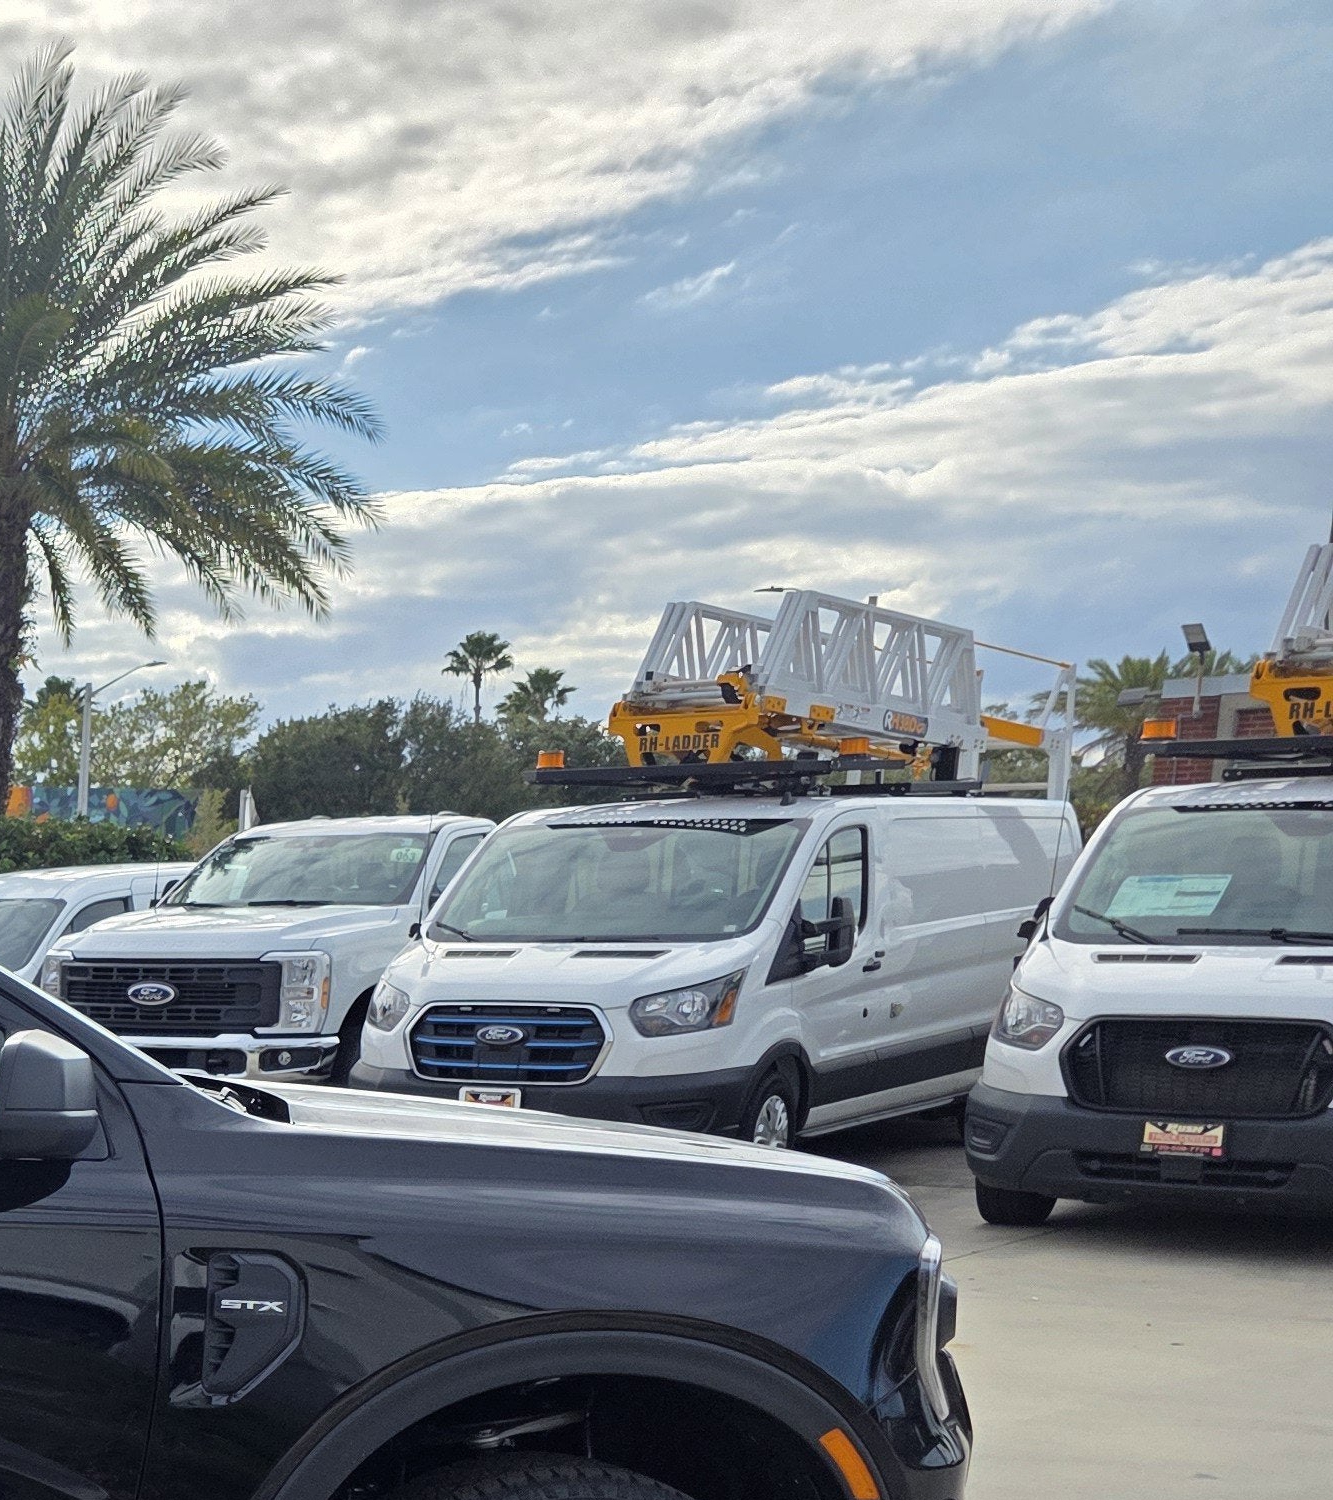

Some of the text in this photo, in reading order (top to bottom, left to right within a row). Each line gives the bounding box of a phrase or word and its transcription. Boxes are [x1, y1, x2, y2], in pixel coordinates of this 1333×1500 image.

[639, 733, 720, 752] RH-LADDER
[138, 988, 164, 1000] Ford
[485, 1027, 513, 1040] Ford
[1178, 1050, 1216, 1064] Ford
[220, 1299, 284, 1313] STX
